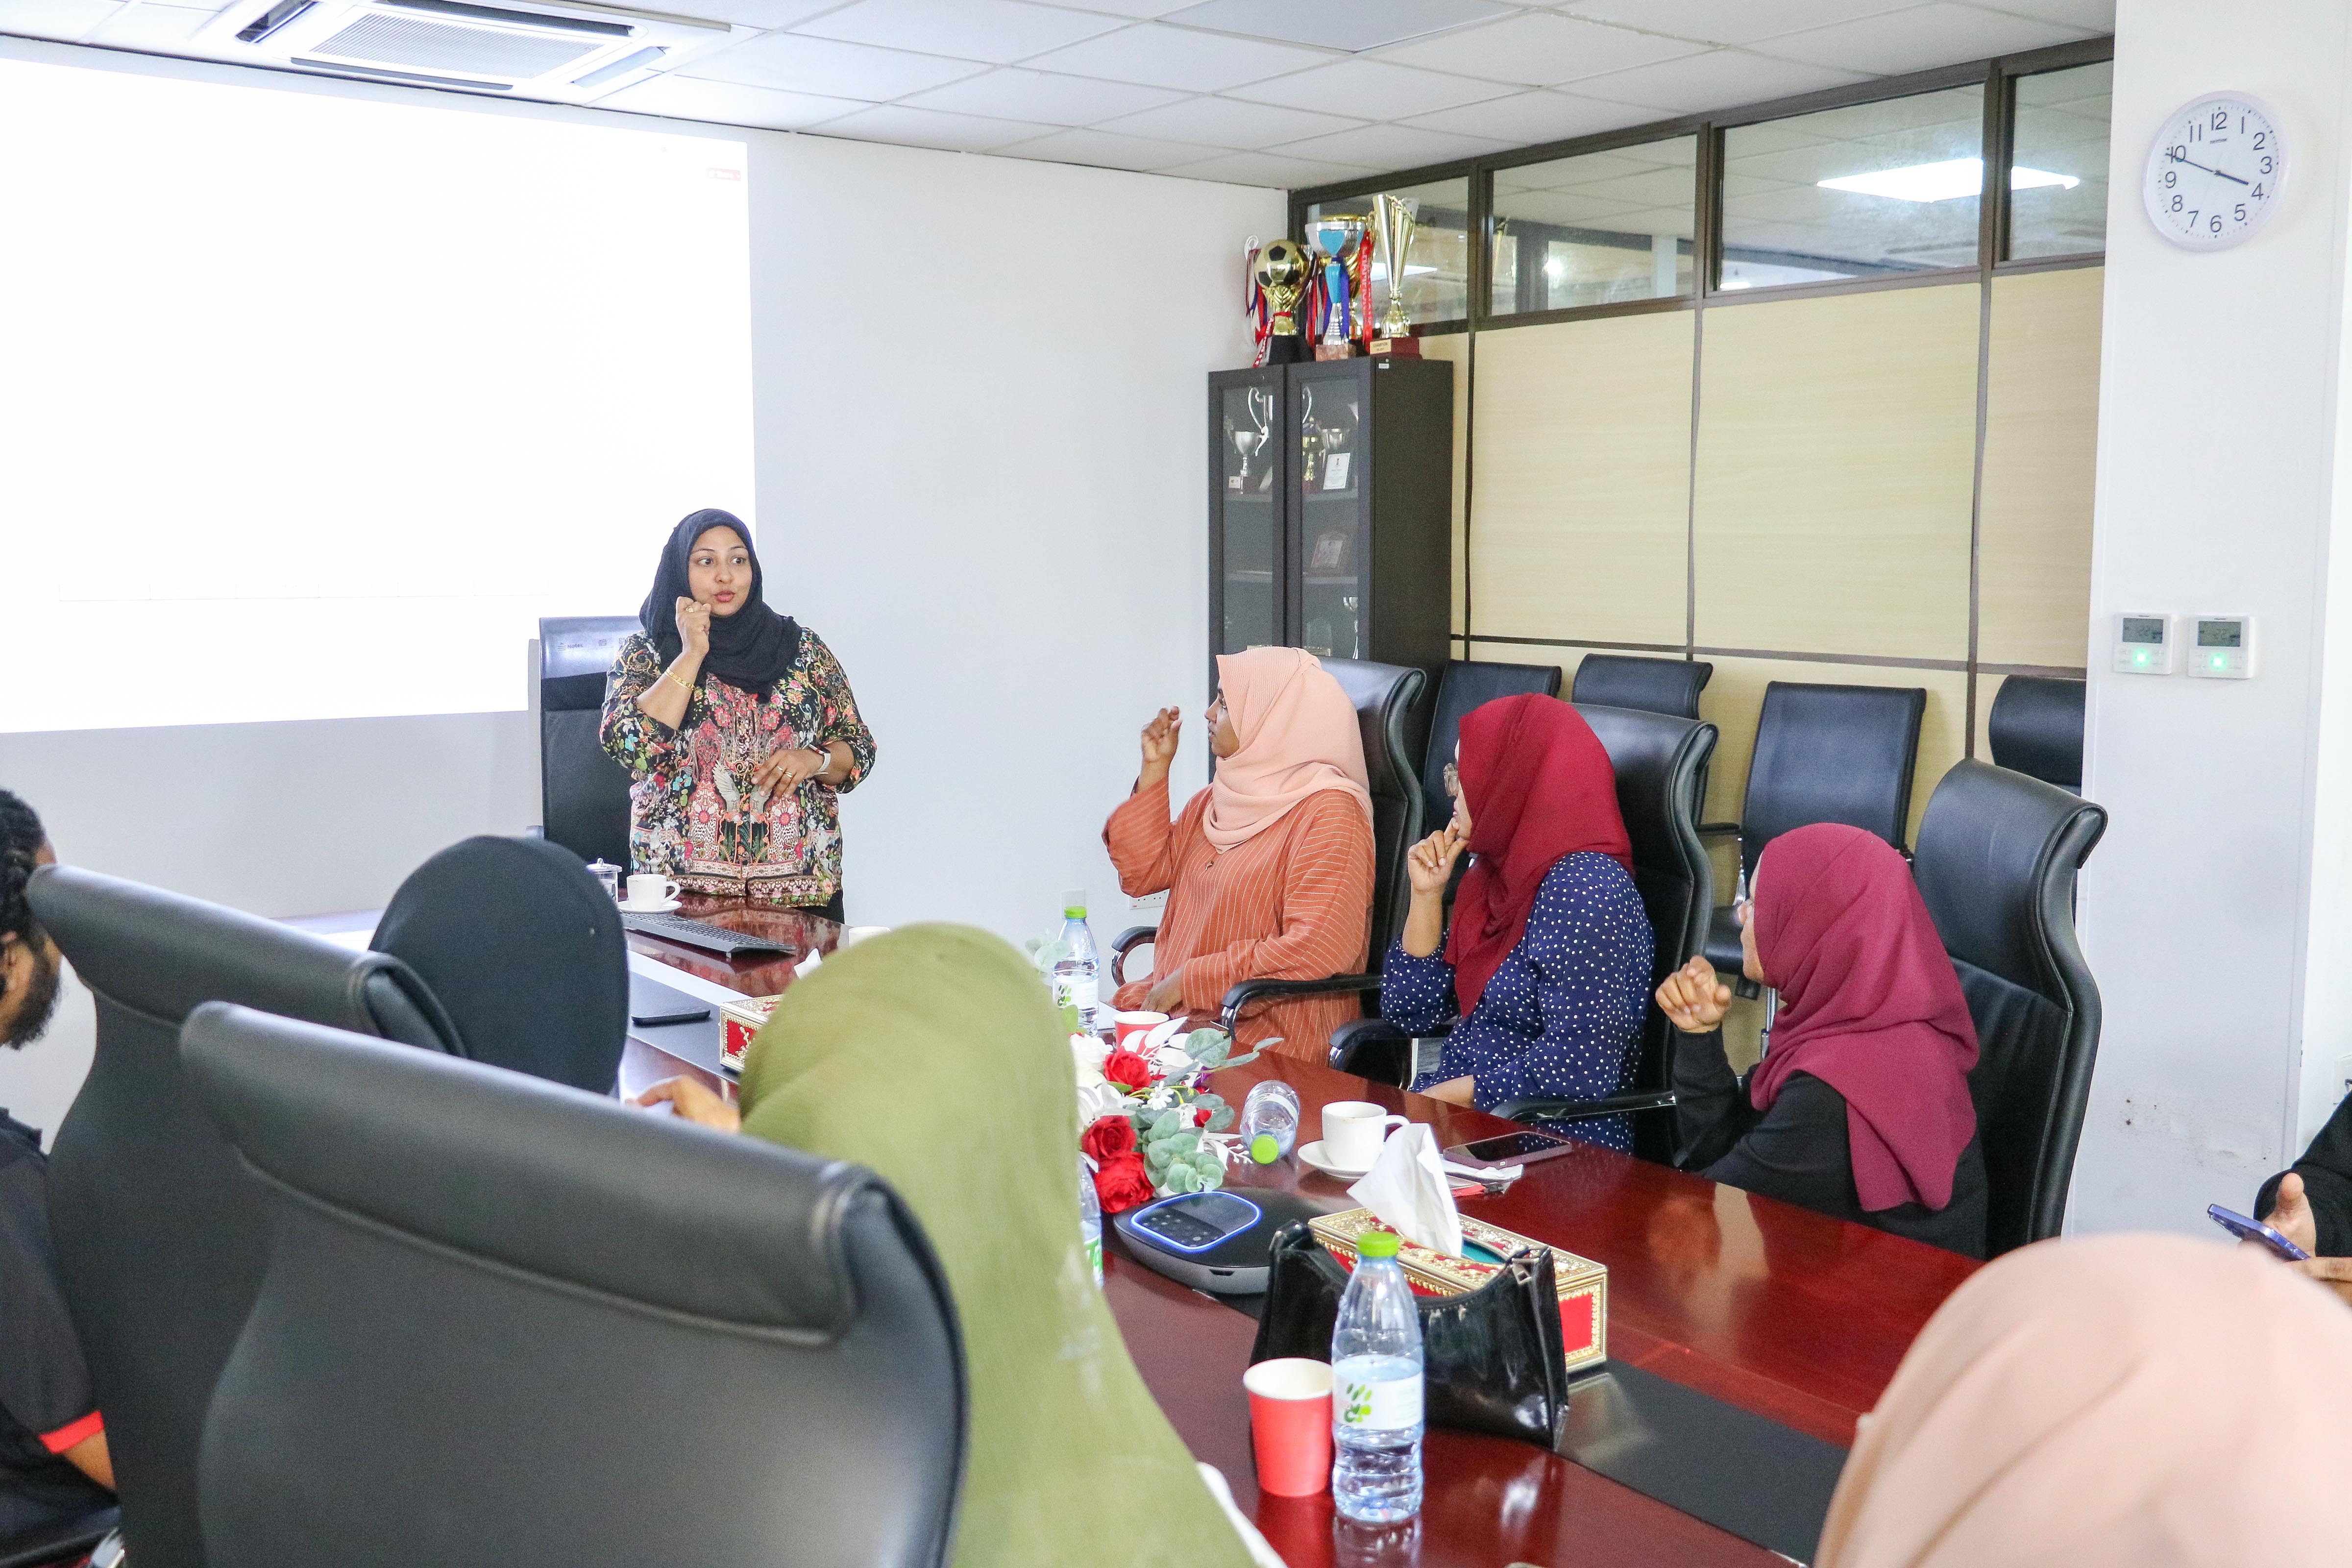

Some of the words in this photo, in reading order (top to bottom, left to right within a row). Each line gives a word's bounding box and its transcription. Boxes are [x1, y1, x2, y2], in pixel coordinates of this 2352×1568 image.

[2211, 112, 2227, 130] 12
[2241, 116, 2244, 134] 1
[2189, 124, 2201, 142] 11
[2253, 132, 2265, 151] 2
[2170, 145, 2186, 164] 10
[2259, 156, 2272, 174] 3
[2165, 172, 2176, 188] 9
[2251, 182, 2264, 200] 4
[2171, 195, 2183, 212] 8
[2234, 203, 2246, 221] 5
[2188, 211, 2199, 228] 7
[2210, 215, 2221, 233] 6
